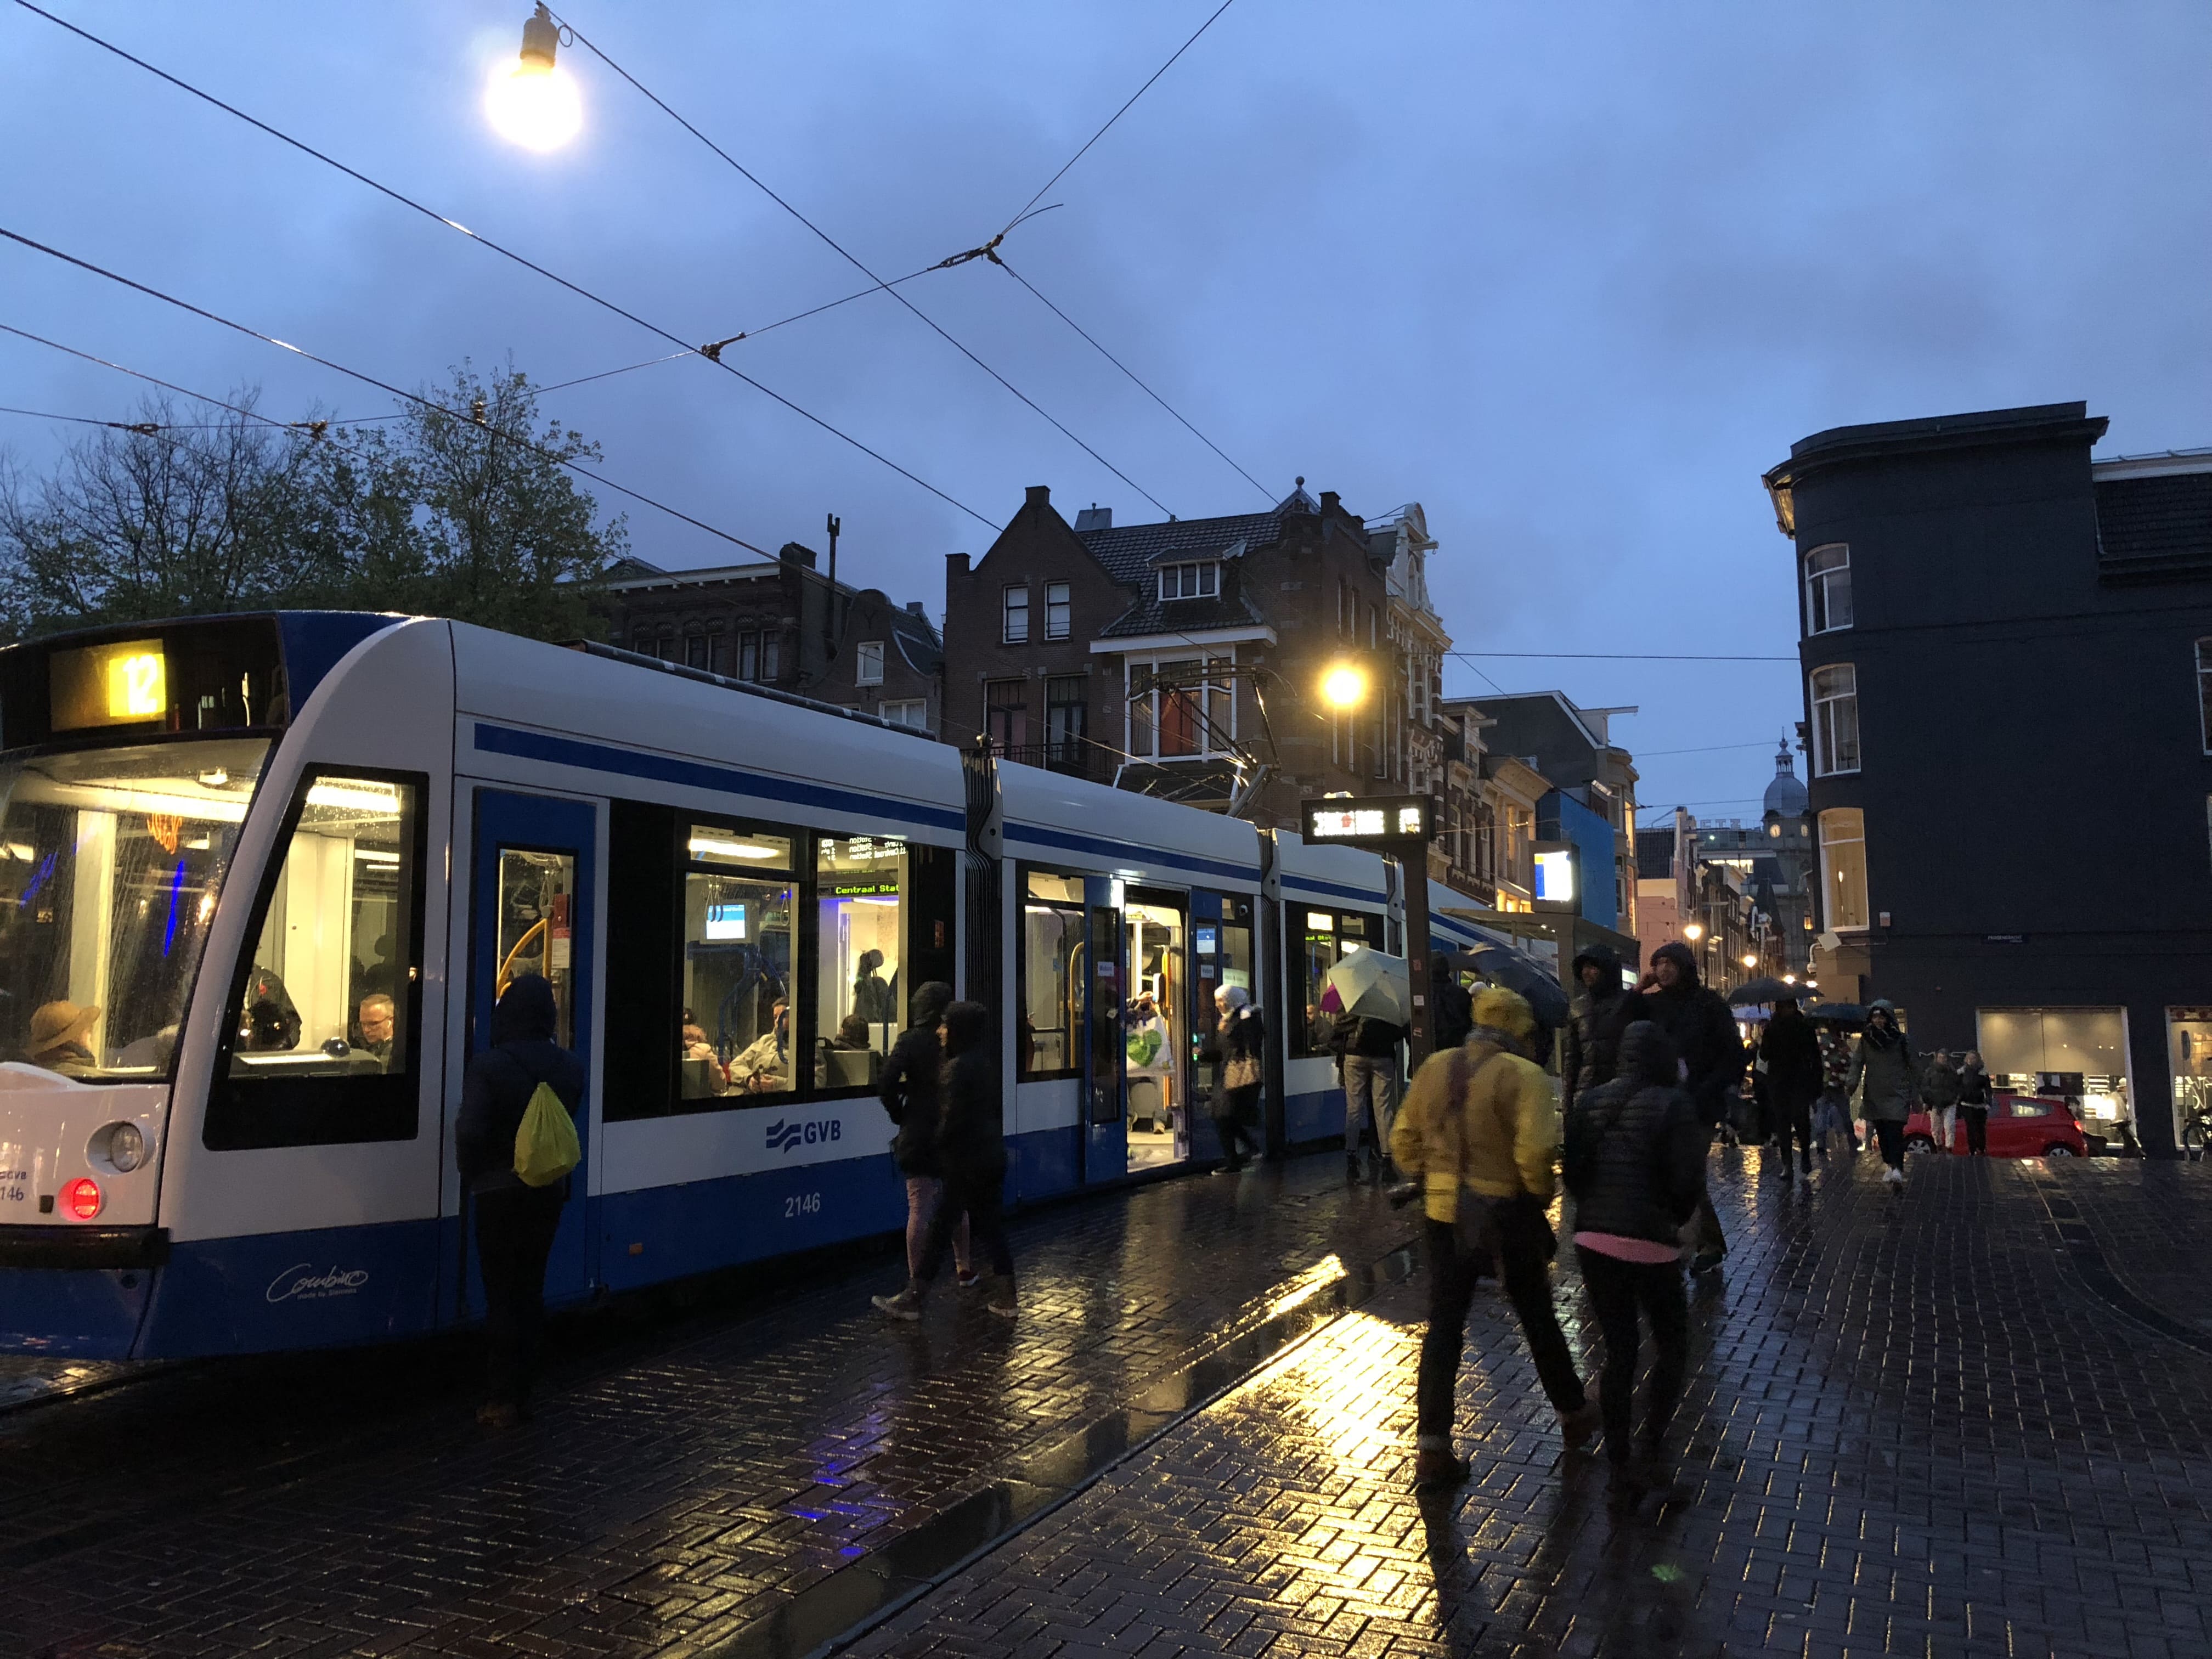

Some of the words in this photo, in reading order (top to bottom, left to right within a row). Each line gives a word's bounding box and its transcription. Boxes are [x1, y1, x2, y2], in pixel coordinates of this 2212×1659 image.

[123, 655, 157, 715] 12
[836, 885, 876, 894] Centraal
[879, 884, 900, 892] Stat
[804, 1120, 841, 1144] GVB
[7, 1171, 27, 1180] GVB
[785, 1192, 821, 1218] 2146
